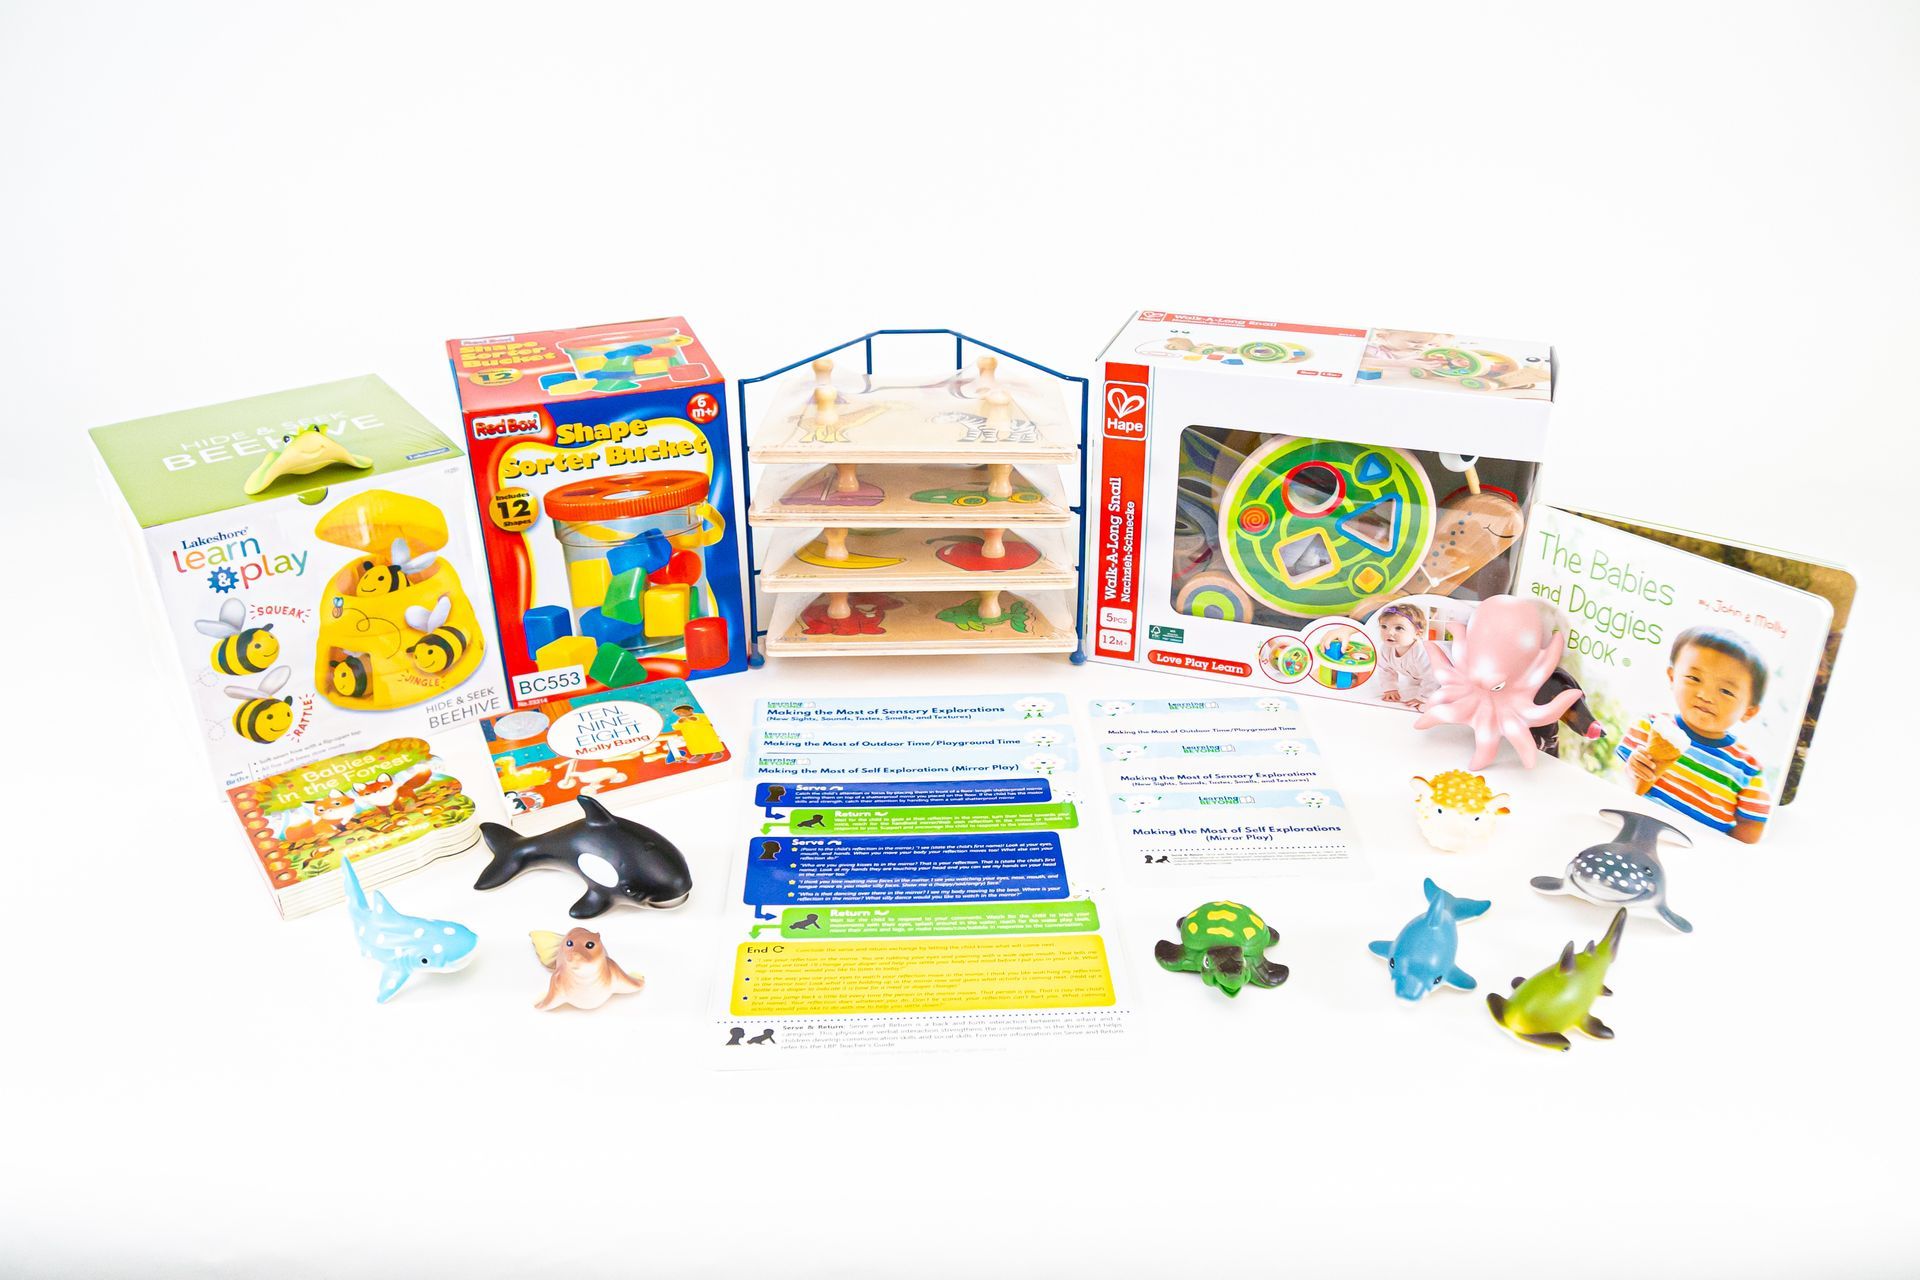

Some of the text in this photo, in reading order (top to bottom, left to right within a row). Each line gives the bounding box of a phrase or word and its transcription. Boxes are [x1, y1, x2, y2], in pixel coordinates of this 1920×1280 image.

[697, 396, 707, 408] 6
[475, 420, 506, 437] Red
[556, 418, 649, 445] Shape
[1106, 417, 1144, 434] Hape
[162, 414, 385, 472] BEEHVE
[181, 431, 248, 451] HIDE
[257, 426, 275, 437] &
[503, 436, 708, 479] Sorter Bucket
[495, 492, 531, 500] Includes
[497, 499, 532, 520] 12
[503, 518, 533, 528] Shapes
[1104, 477, 1123, 601] Walk-A-Long Snail
[172, 537, 261, 574] learn
[217, 550, 308, 590] & play
[1539, 530, 1677, 607] The Babies
[257, 605, 305, 619] SQUEAK
[1531, 581, 1664, 645] and Doggies
[1712, 599, 1743, 617] John
[1567, 628, 1618, 667] BOOK
[1156, 653, 1244, 675] Love Play Learn
[405, 673, 441, 688] JINGLE
[519, 671, 582, 695] BC553
[425, 686, 495, 715] HIDE & SEEK
[767, 709, 811, 717] Making
[931, 706, 1005, 715] Explorations
[293, 697, 314, 738] RATTLE
[428, 697, 501, 730] BEEHIVE
[575, 722, 643, 748] EIGHT
[575, 734, 651, 757] Molly Bang
[907, 739, 995, 747] Time/Playground
[301, 754, 376, 783] Babies
[303, 778, 339, 796] the
[342, 753, 413, 782] Forest
[883, 766, 949, 774] Explorations
[1255, 771, 1317, 779] Explorations
[791, 838, 825, 846] Serve
[1132, 828, 1177, 837] Making
[1179, 827, 1198, 835] the
[1231, 826, 1241, 834] of
[1268, 825, 1342, 834] Explorations
[1245, 834, 1274, 842] Play)
[830, 909, 871, 917] Return
[747, 946, 768, 954] End
